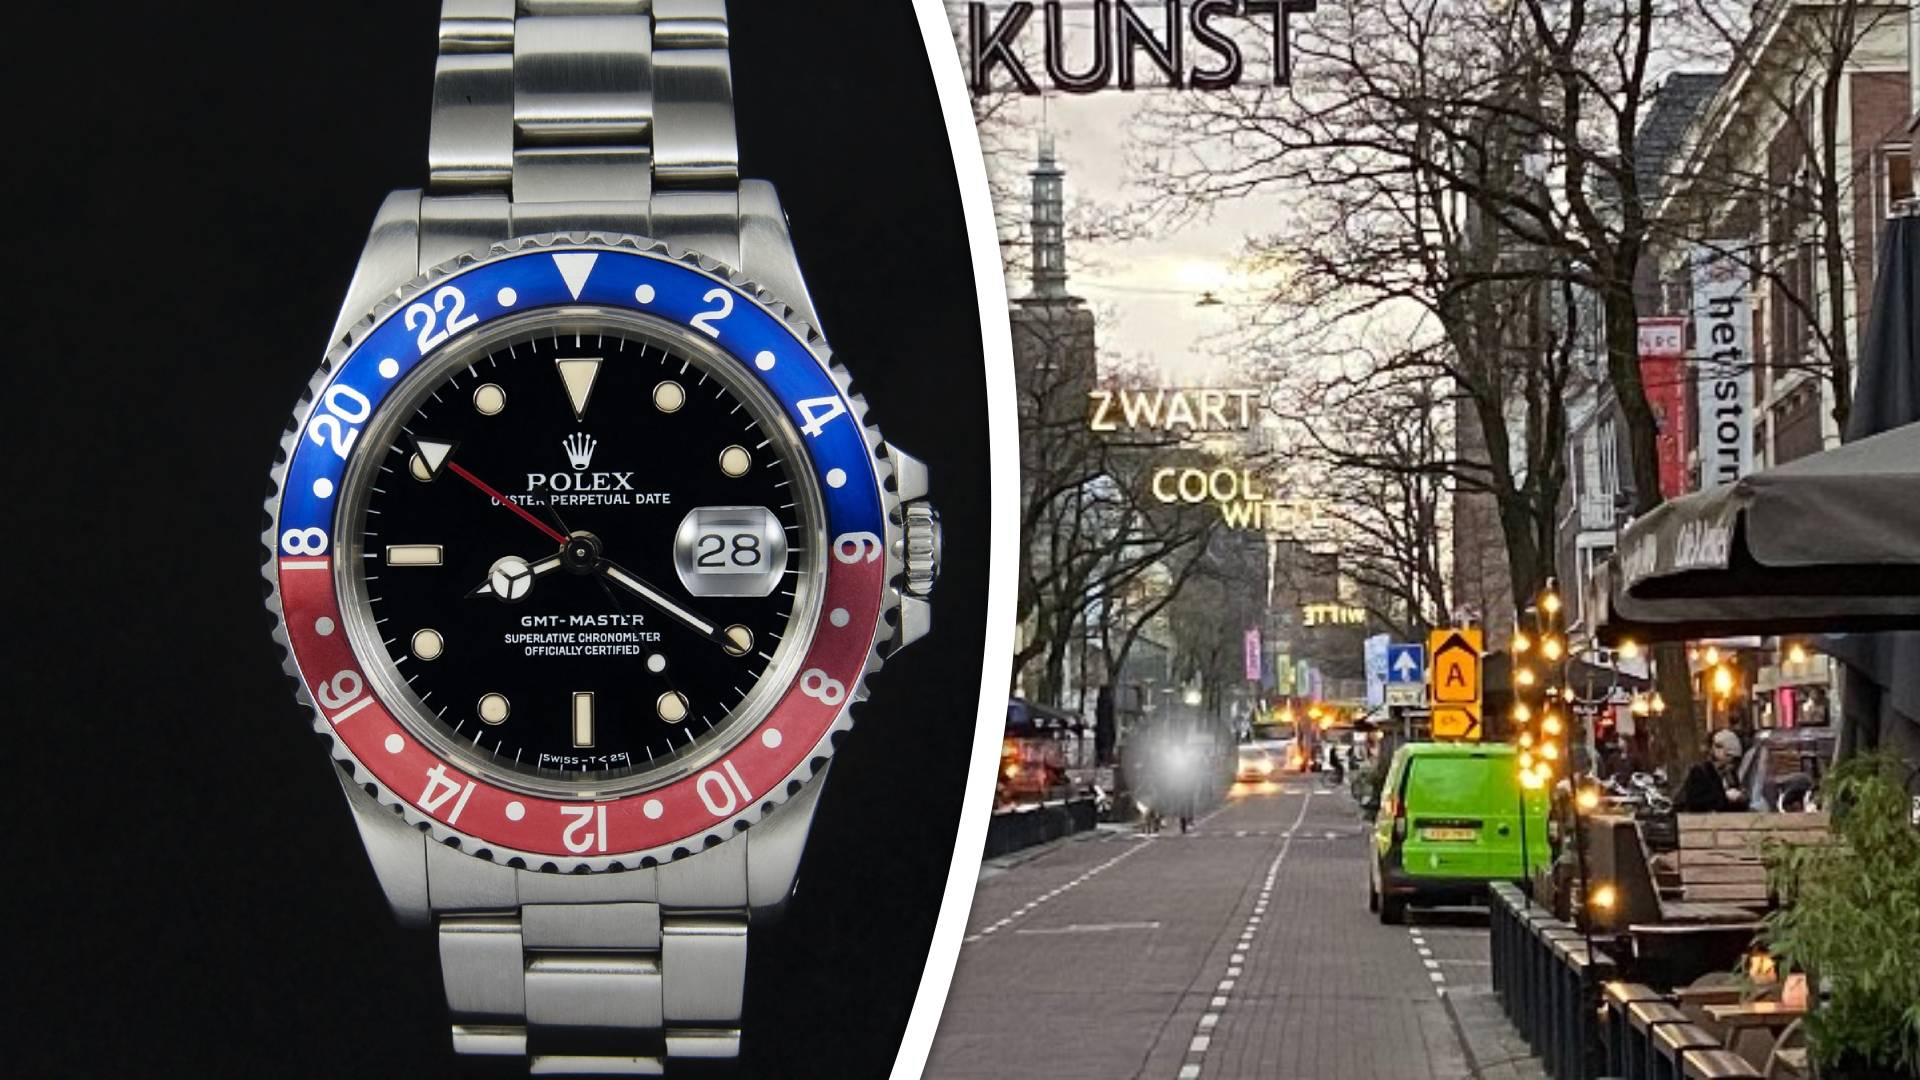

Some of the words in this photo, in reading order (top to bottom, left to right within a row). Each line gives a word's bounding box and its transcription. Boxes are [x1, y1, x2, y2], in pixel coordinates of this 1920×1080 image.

[968, 0, 1317, 96] KUNST
[403, 285, 479, 355] 22
[689, 288, 734, 338] 2
[308, 383, 371, 461] 20
[796, 395, 846, 438] 4
[1089, 388, 1262, 432] ZWART
[550, 493, 631, 506] PERPETUAL
[635, 493, 671, 505] DATE
[1152, 466, 1264, 504] COOL
[281, 526, 329, 570] 18
[696, 533, 763, 568] 28
[832, 531, 882, 564] 6
[504, 633, 576, 644] SUPERLATIVE
[524, 646, 583, 656] OFFICIALLY
[584, 645, 640, 655] CERTIFIED
[799, 667, 846, 706] 8
[1445, 661, 1467, 687] A
[317, 669, 375, 725] 16
[416, 763, 477, 825] 14
[696, 759, 753, 818] 10
[560, 805, 608, 853] 12
